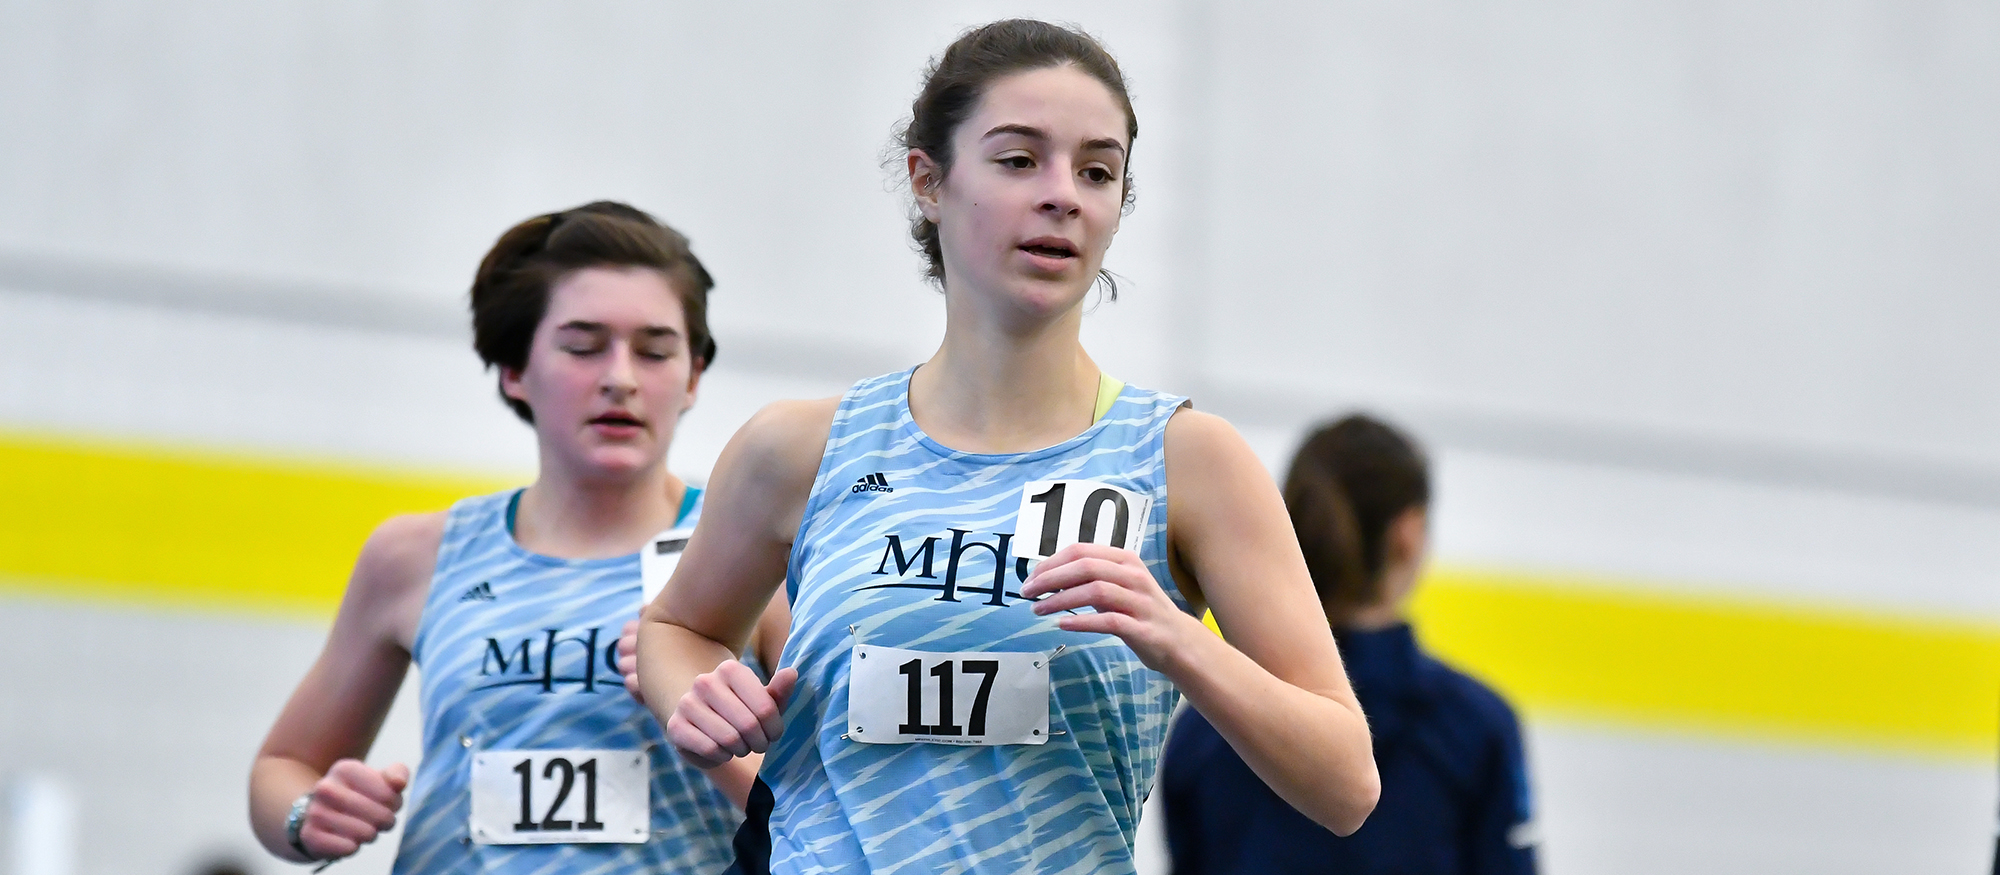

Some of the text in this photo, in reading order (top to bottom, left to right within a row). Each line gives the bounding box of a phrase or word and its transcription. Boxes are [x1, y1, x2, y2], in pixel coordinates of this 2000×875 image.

[852, 482, 894, 494] adidas
[1030, 483, 1129, 557] 10
[871, 527, 1029, 607] MH
[899, 658, 999, 736] 117
[513, 758, 604, 831] 121
